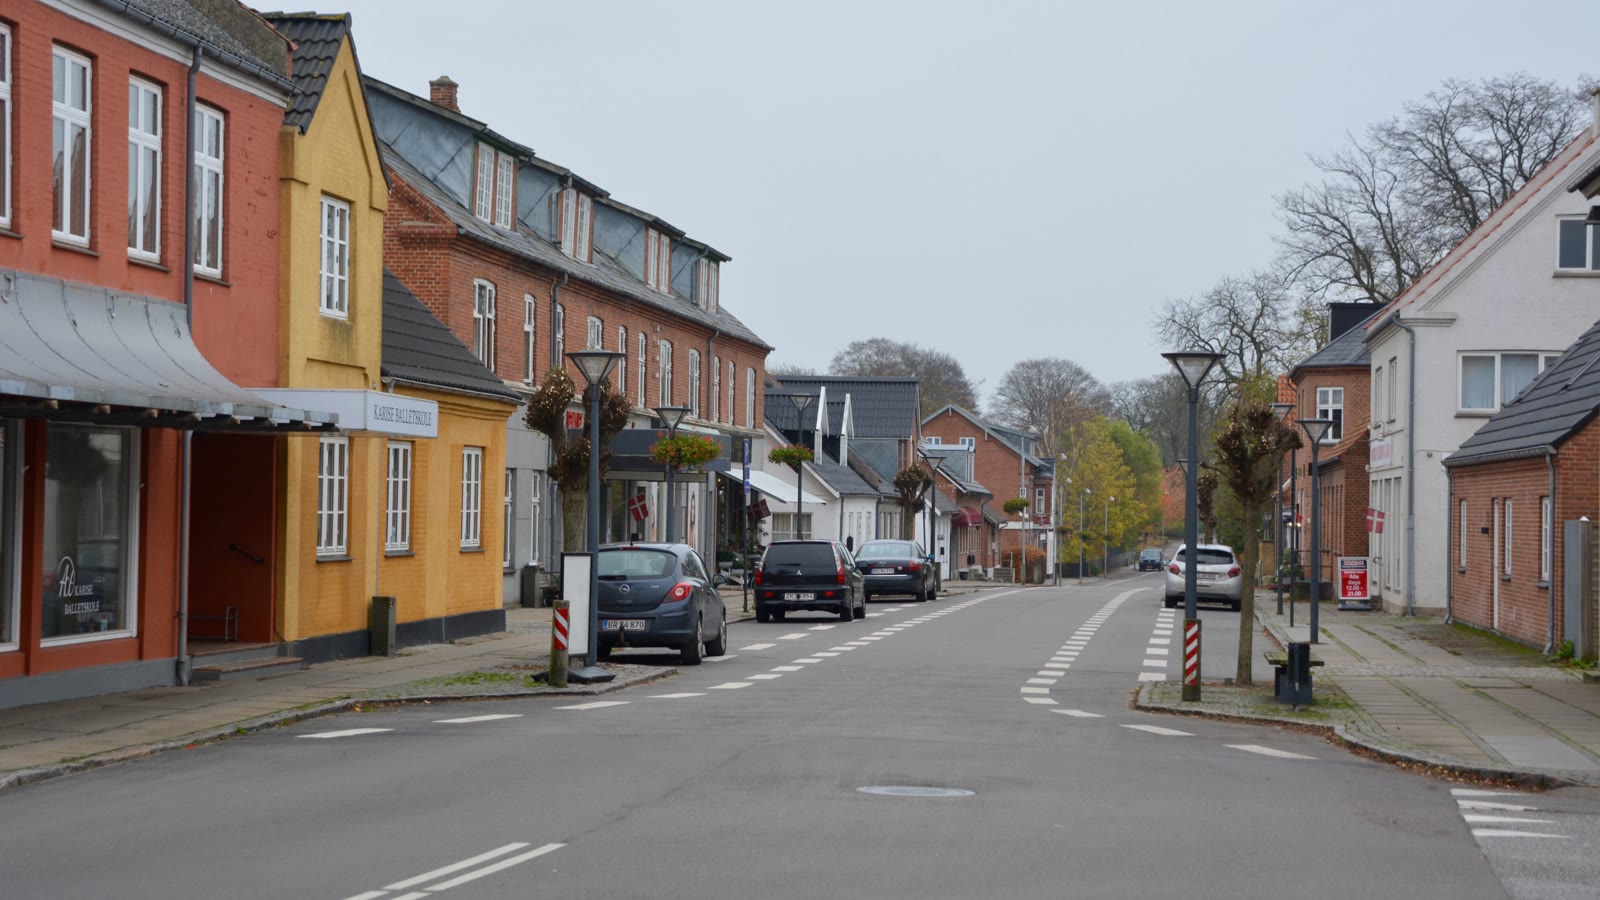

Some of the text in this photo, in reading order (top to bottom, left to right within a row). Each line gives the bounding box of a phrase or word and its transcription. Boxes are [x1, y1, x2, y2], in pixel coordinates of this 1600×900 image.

[373, 404, 432, 427] KARISE BALLETSKOLE
[74, 584, 94, 596] KARISE
[64, 601, 100, 615] BALLETSKOLE
[608, 621, 618, 629] BR
[629, 621, 644, 629] 870
